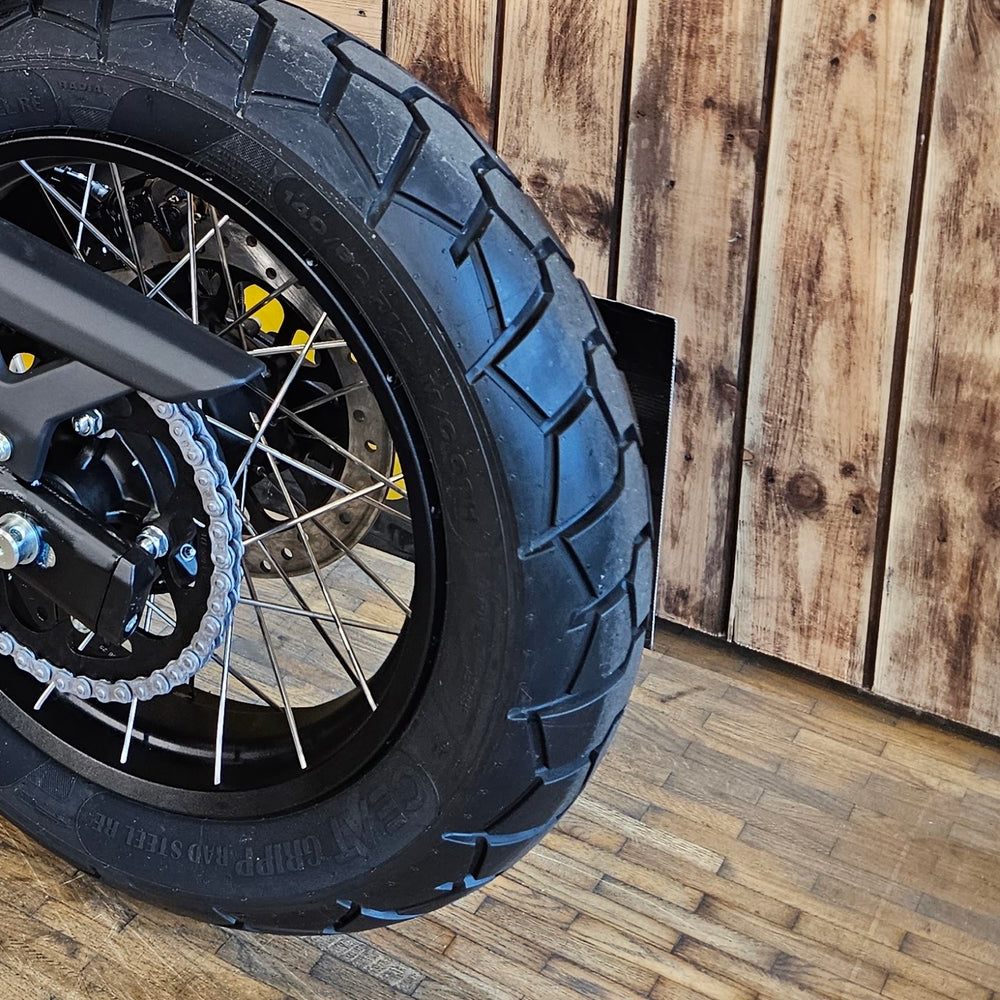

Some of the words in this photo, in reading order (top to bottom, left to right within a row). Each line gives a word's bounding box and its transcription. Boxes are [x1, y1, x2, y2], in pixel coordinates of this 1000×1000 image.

[92, 812, 120, 839] RE
[125, 824, 184, 861] STEEL
[187, 843, 229, 867] RAD
[234, 835, 322, 877] GRIPP
